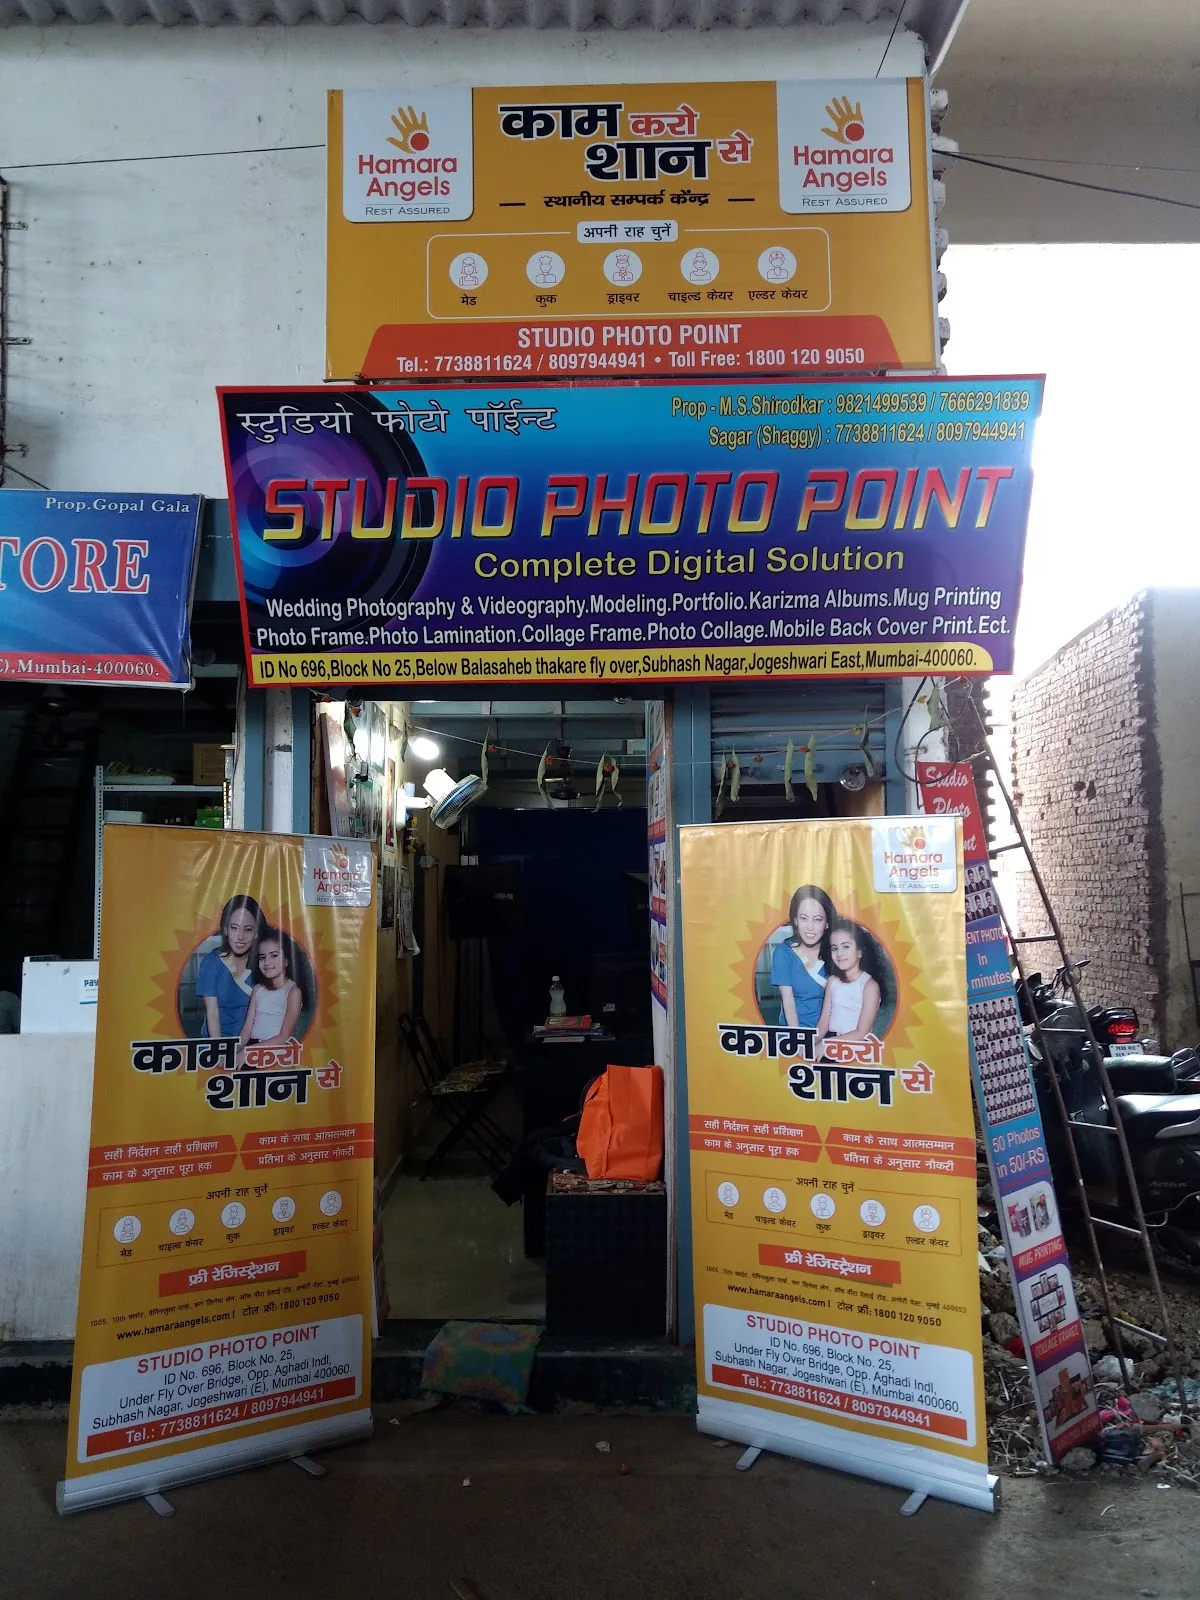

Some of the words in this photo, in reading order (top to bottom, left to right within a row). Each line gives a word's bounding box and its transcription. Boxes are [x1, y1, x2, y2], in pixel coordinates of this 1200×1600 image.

[499, 103, 624, 139] काम
[629, 104, 698, 137] करो
[358, 154, 457, 175] Hamara
[587, 140, 712, 180] शान
[719, 131, 751, 164] से
[793, 144, 894, 165] Hamara
[366, 176, 450, 200] Angels
[802, 167, 886, 190] Angels
[544, 191, 606, 207] स्थानीय
[611, 190, 665, 206] सम्पर्क
[583, 224, 618, 238] अपनी
[624, 226, 646, 238] राह
[651, 223, 671, 241] चुनें
[460, 293, 477, 306] मेड
[535, 294, 558, 307] कुक
[606, 292, 640, 304] ड्राइवर
[668, 290, 701, 303] चाइल्ड
[707, 289, 734, 302] केयर
[748, 288, 777, 301] एल्डर
[782, 287, 808, 300] केयर
[517, 326, 596, 348] STUDIO
[600, 325, 674, 347] PHOTO
[679, 324, 742, 346] POINT
[396, 356, 430, 373] Tel.:
[434, 354, 532, 372] 7738811624
[548, 352, 647, 370] 8097944941
[668, 351, 697, 367] Toll
[701, 350, 741, 367] Free:
[746, 348, 785, 365] 1800
[791, 348, 821, 365] 120
[826, 347, 865, 364] 9050
[672, 397, 706, 421] Prop
[719, 395, 824, 416] M.S.Shirodkar
[836, 394, 926, 414] 9821499539
[939, 392, 1030, 411] 7666291839
[236, 403, 353, 443] स्टुडियो
[371, 400, 449, 434] फोटो
[465, 399, 558, 434] पॉईन्ट
[709, 427, 752, 450] Sagar
[756, 425, 822, 448] (Shaggy)
[835, 424, 924, 444] 7738811624
[936, 422, 1025, 442] 8097944941
[45, 497, 144, 513] Prop.Gopal
[151, 500, 190, 513] Gala
[263, 476, 520, 541] STUDIO
[540, 470, 780, 538] PHOTO
[797, 467, 1014, 533] POINT
[474, 552, 636, 583] Complete
[647, 547, 754, 580] Digital
[767, 545, 904, 573] Solution
[265, 598, 342, 621] Wedding
[347, 597, 455, 620] Photography
[461, 597, 474, 615] &
[934, 587, 1002, 609] Printing
[256, 628, 307, 647] Photo
[830, 618, 873, 637] Back
[878, 617, 928, 636] Cover
[260, 661, 275, 678] ID
[279, 661, 298, 678] No
[372, 659, 391, 677] No
[462, 657, 532, 676] Balasaheb
[535, 656, 587, 675] thakare
[590, 656, 606, 679] fly
[926, 766, 968, 787] Studio
[884, 852, 943, 864] Hamara
[889, 865, 939, 880] Angels
[971, 971, 1012, 989] minutes
[131, 1037, 240, 1073] काम
[245, 1037, 303, 1068] करो
[717, 1024, 818, 1061] काम
[823, 1033, 883, 1064] करो
[207, 1069, 311, 1110] शान
[317, 1060, 343, 1088] से
[788, 1063, 895, 1106] शान
[901, 1061, 934, 1093] से
[704, 1119, 720, 1130] सही
[723, 1120, 749, 1133] निर्देशन
[753, 1124, 769, 1135] सही
[773, 1125, 804, 1138] प्रशिक्षण
[992, 1137, 1005, 1153] 50
[1007, 1126, 1041, 1148] Photos
[843, 1133, 861, 1144] काम
[864, 1133, 873, 1144] के
[878, 1136, 898, 1147] साथ
[902, 1138, 955, 1151] आत्मसम्मान
[997, 1162, 1007, 1179] in
[796, 1177, 818, 1188] अपनी
[823, 1180, 837, 1190] राह
[841, 1180, 855, 1194] चुनें
[784, 1250, 802, 1265] फ्री
[806, 1250, 873, 1276] रेजिस्ट्रेशन
[727, 1284, 826, 1307] www.hamaraangels.com
[837, 1299, 854, 1313] टोल
[873, 1307, 897, 1320] 1800
[899, 1311, 916, 1324] 120
[917, 1315, 942, 1327] 9050
[137, 1347, 204, 1374] STUDIO
[209, 1335, 267, 1359] PHOTO
[272, 1325, 320, 1346] POINT
[746, 1314, 804, 1337] STUDIO
[808, 1327, 864, 1350] PHOTO
[869, 1337, 920, 1360] POINT
[164, 1375, 175, 1385] ID
[179, 1367, 198, 1380] No.
[201, 1363, 225, 1378] 696,
[228, 1357, 257, 1372] Block
[260, 1353, 279, 1365] No.
[280, 1350, 296, 1364] 25,
[734, 1343, 763, 1356] Under
[766, 1349, 781, 1363] Fly
[783, 1352, 806, 1366] Over
[808, 1358, 844, 1376] Bridge,
[846, 1366, 871, 1381] Opp.
[874, 1372, 911, 1389] Aghadi
[160, 1407, 239, 1436] 7738811624
[251, 1388, 324, 1414] 8097944941
[770, 1379, 841, 1406] 7738811624
[852, 1399, 931, 1427] 8097944941
